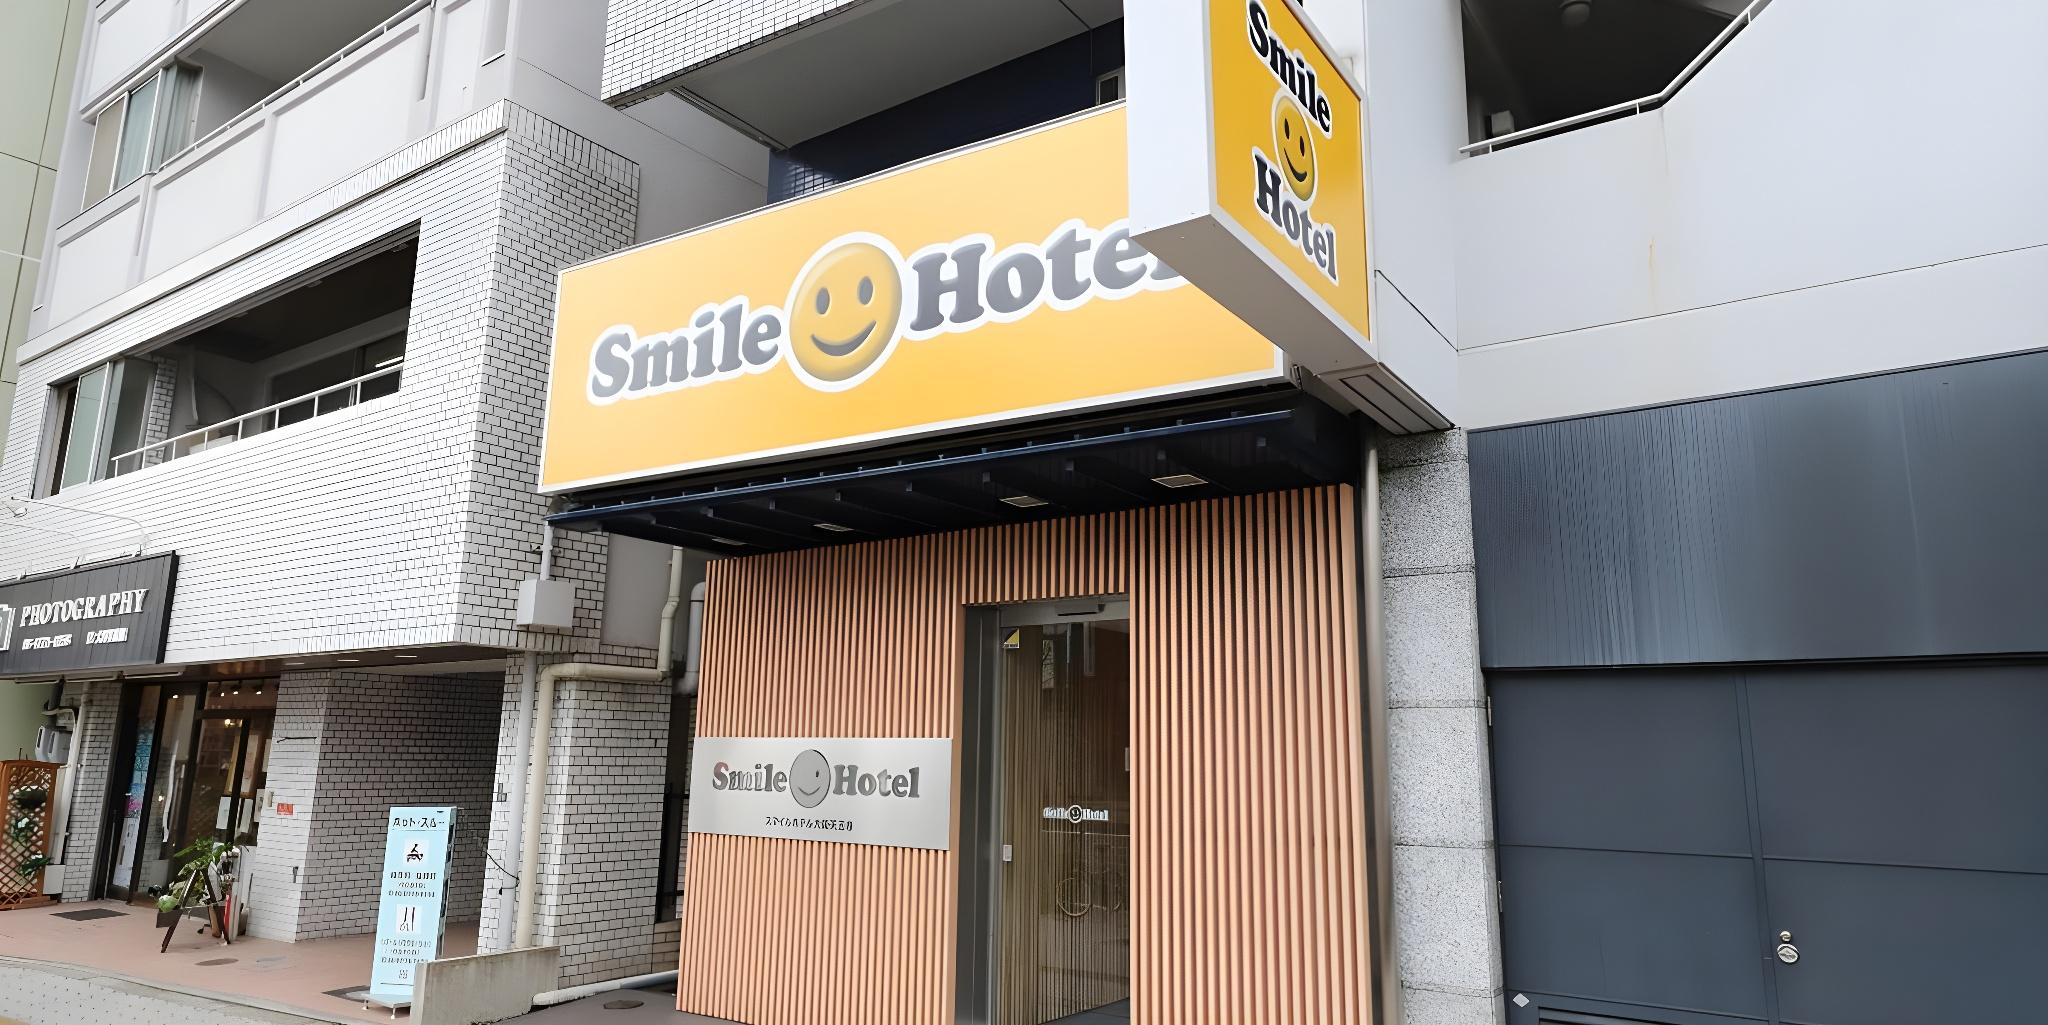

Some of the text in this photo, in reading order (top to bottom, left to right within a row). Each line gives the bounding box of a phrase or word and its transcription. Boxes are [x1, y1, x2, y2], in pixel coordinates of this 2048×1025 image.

[1248, 2, 1331, 133] Smile
[1255, 154, 1337, 281] Hotel
[591, 227, 1181, 398] Smile Hote
[19, 588, 149, 628] PHOTOGRAPHY
[712, 762, 920, 799] Smile Hotel
